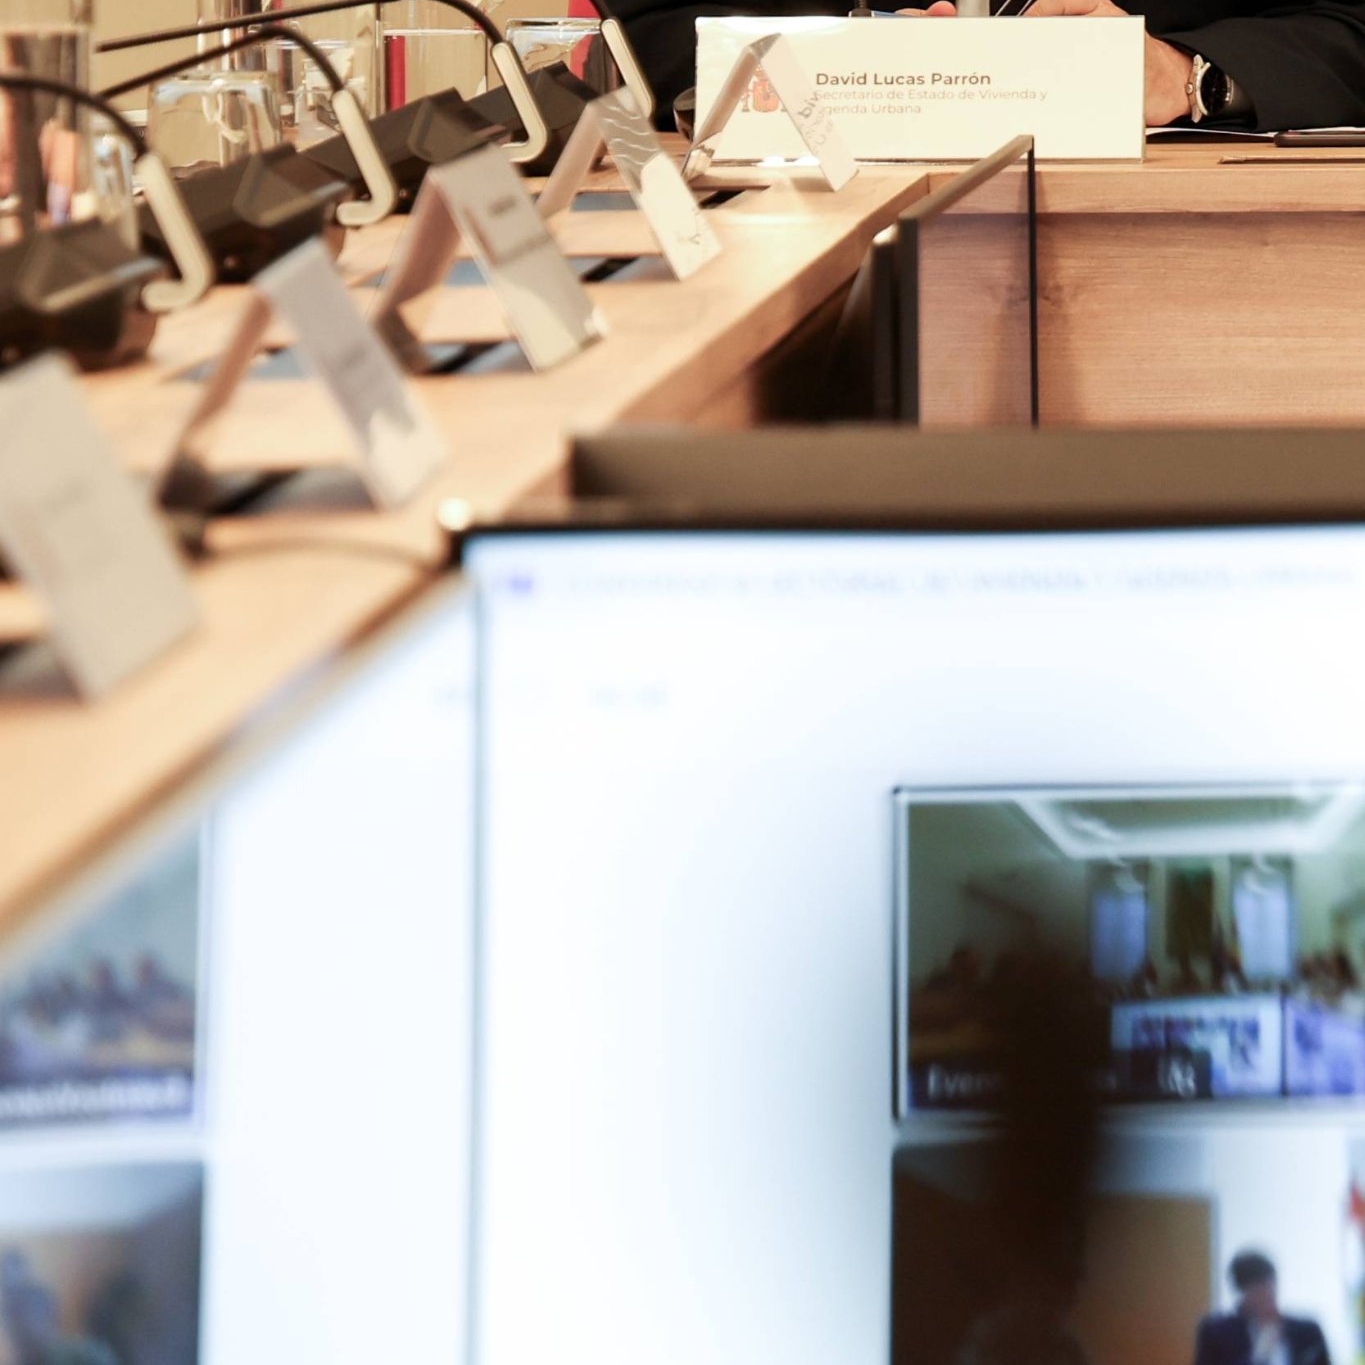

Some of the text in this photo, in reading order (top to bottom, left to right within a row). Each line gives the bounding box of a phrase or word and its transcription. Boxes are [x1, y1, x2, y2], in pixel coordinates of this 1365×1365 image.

[815, 72, 991, 86] David Lucas Parrón
[814, 89, 1048, 102] Secretario de Estado de Vivienda y
[822, 103, 922, 116] genda Urbana
